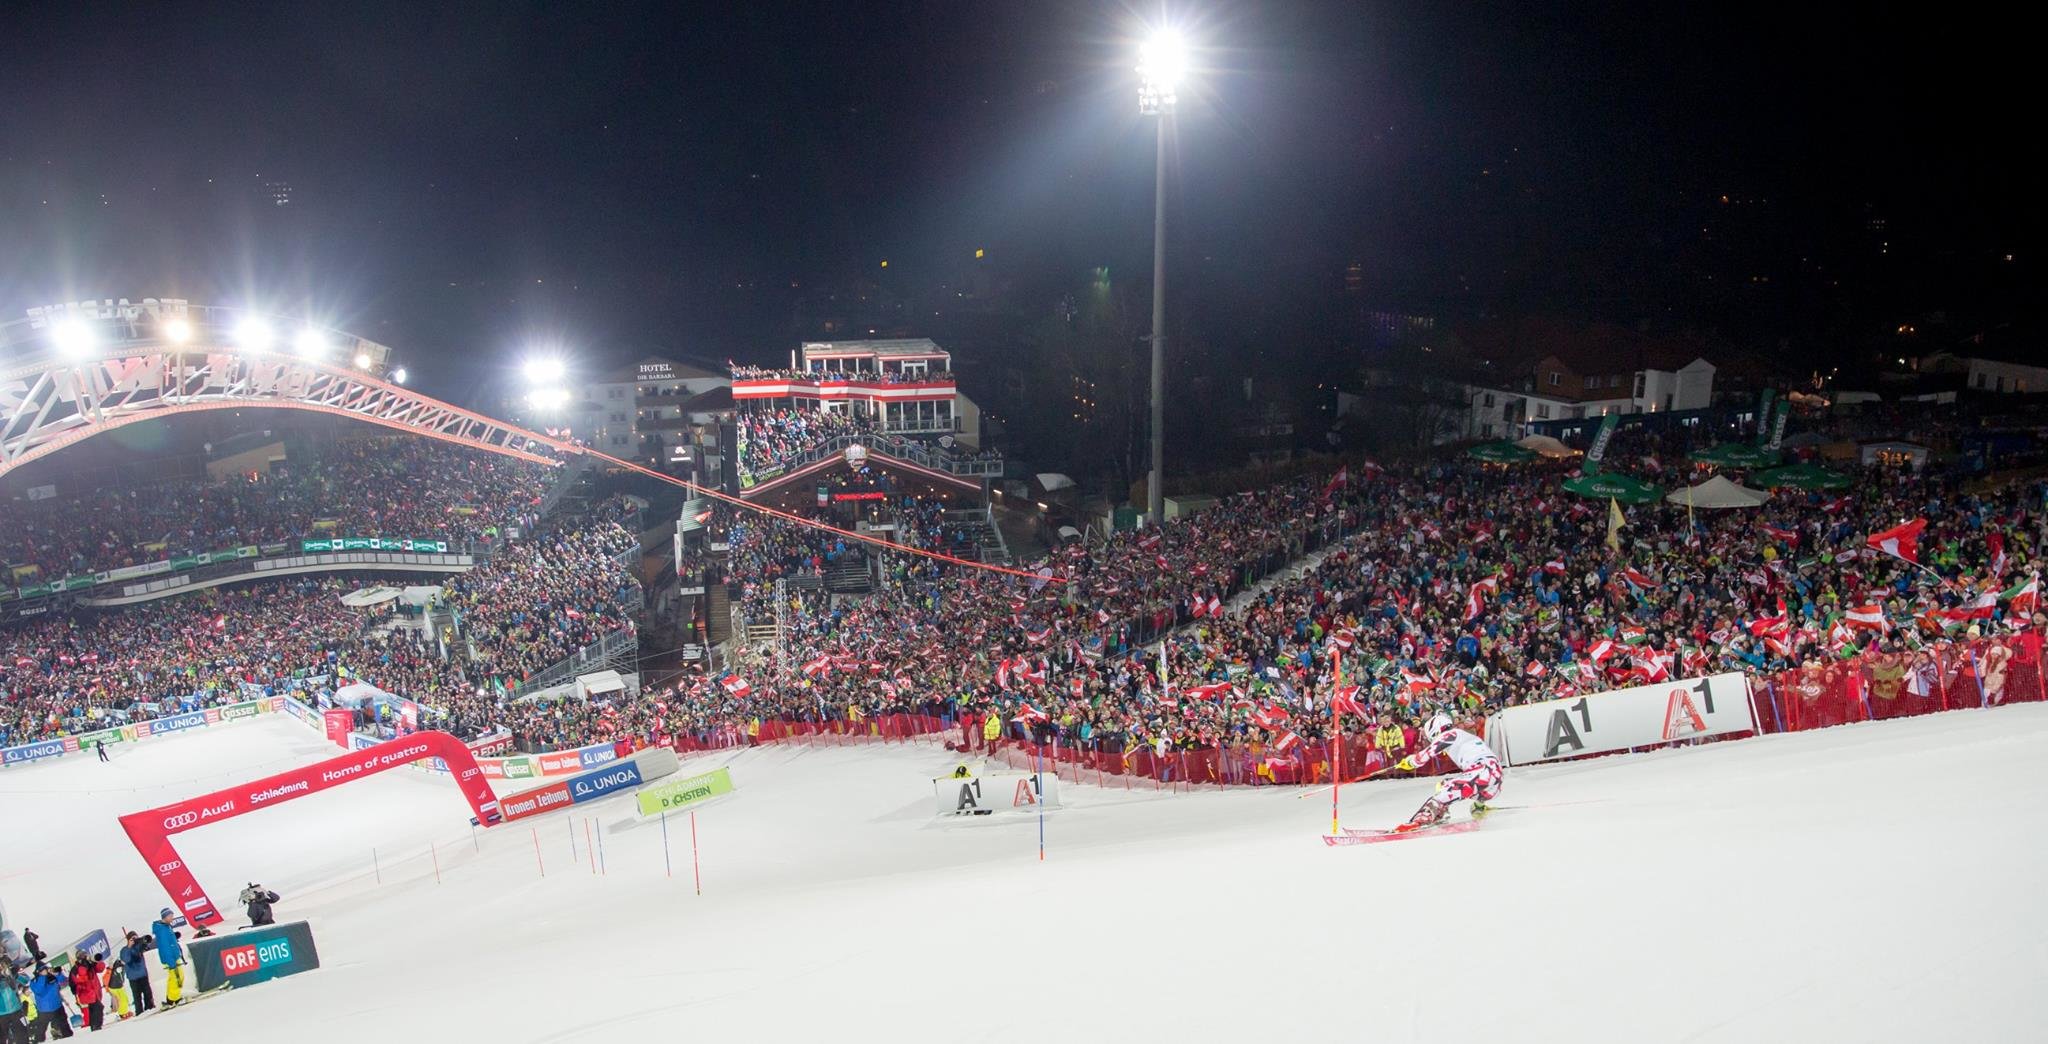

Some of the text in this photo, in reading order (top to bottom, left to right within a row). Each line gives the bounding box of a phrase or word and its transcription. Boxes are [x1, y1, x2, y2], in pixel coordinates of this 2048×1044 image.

[639, 363, 672, 373] HOTEL
[169, 715, 205, 730] UNIQA
[1662, 678, 1715, 739] A1
[1543, 697, 1592, 758] A1
[24, 744, 64, 759] UNIQA
[201, 744, 428, 819] Audi Schladming Home of quattro
[594, 769, 637, 790] UNIQA
[1013, 774, 1039, 807] A1
[504, 799, 536, 816] Kronen
[537, 789, 569, 807] Zeitung
[957, 778, 981, 810] A1
[225, 942, 289, 970] ORF eins
